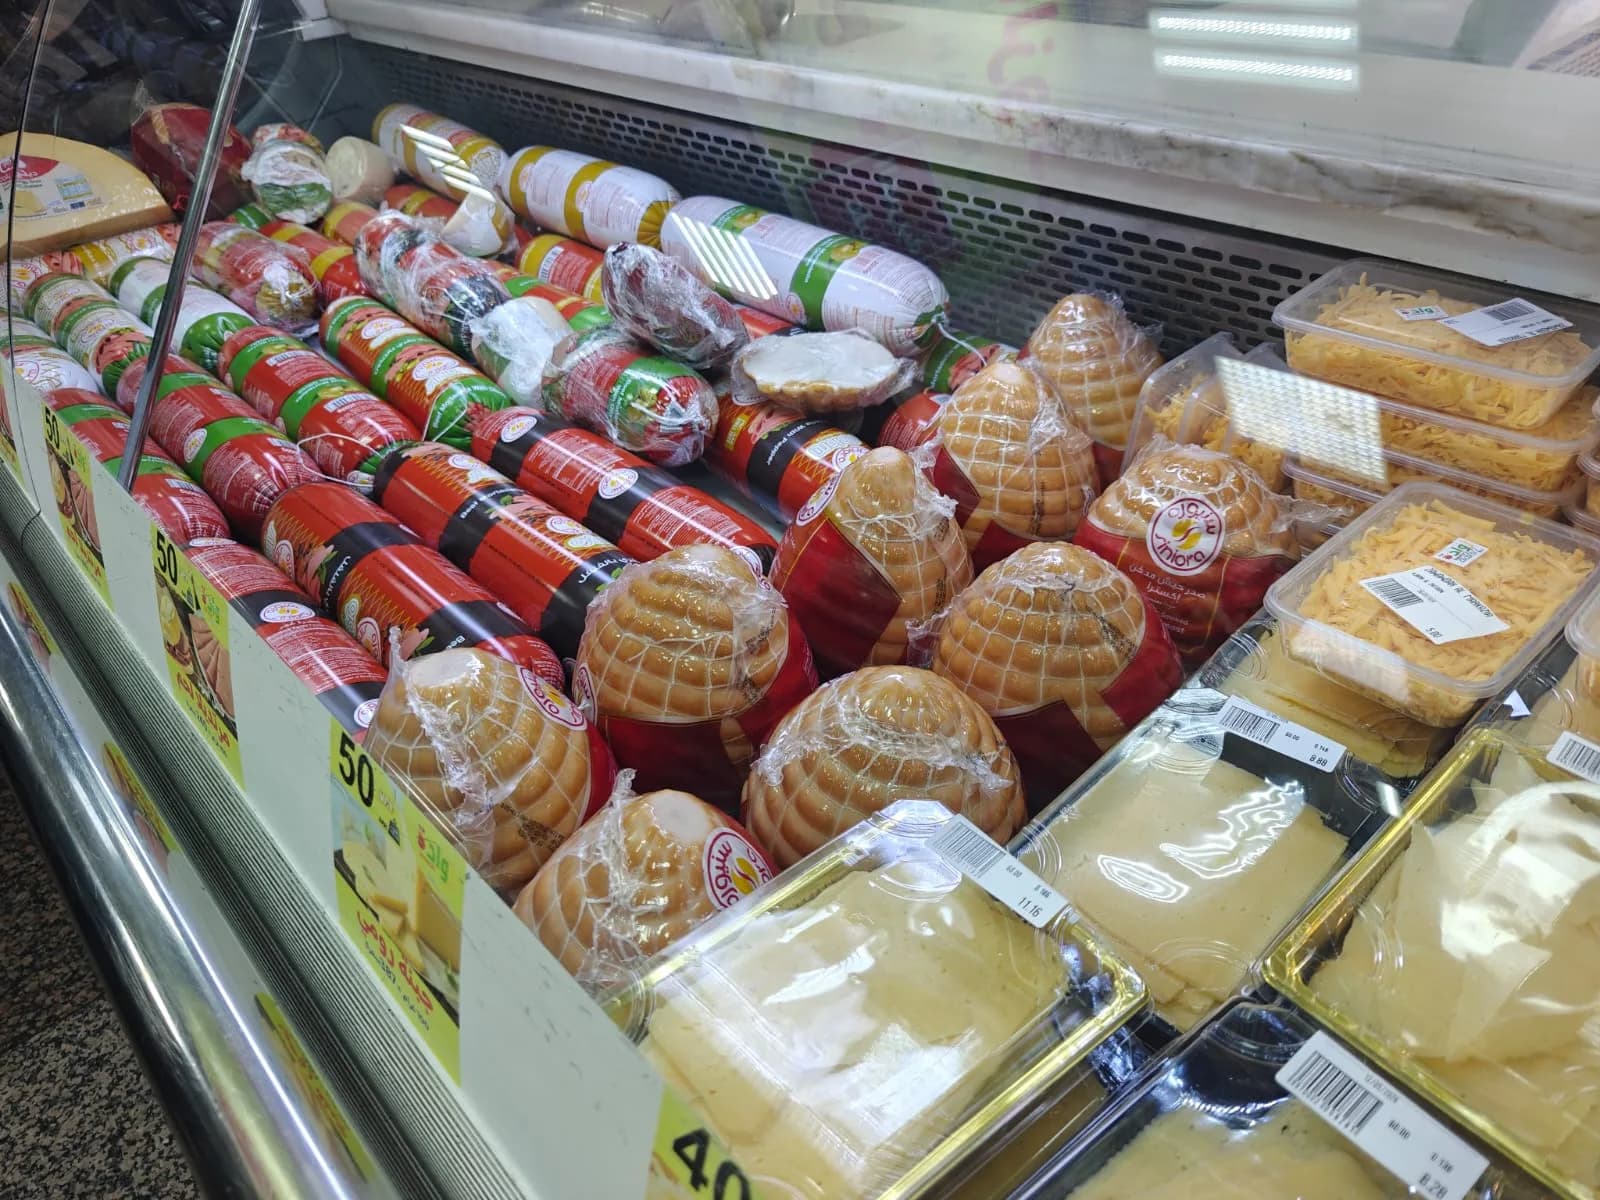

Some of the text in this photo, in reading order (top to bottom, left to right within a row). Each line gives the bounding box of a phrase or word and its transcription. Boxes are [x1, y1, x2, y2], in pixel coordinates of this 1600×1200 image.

[45, 407, 60, 450] 50
[156, 528, 178, 586] 50
[338, 731, 375, 808] 50
[1018, 896, 1043, 918] 11.16
[672, 1128, 753, 1200] 40
